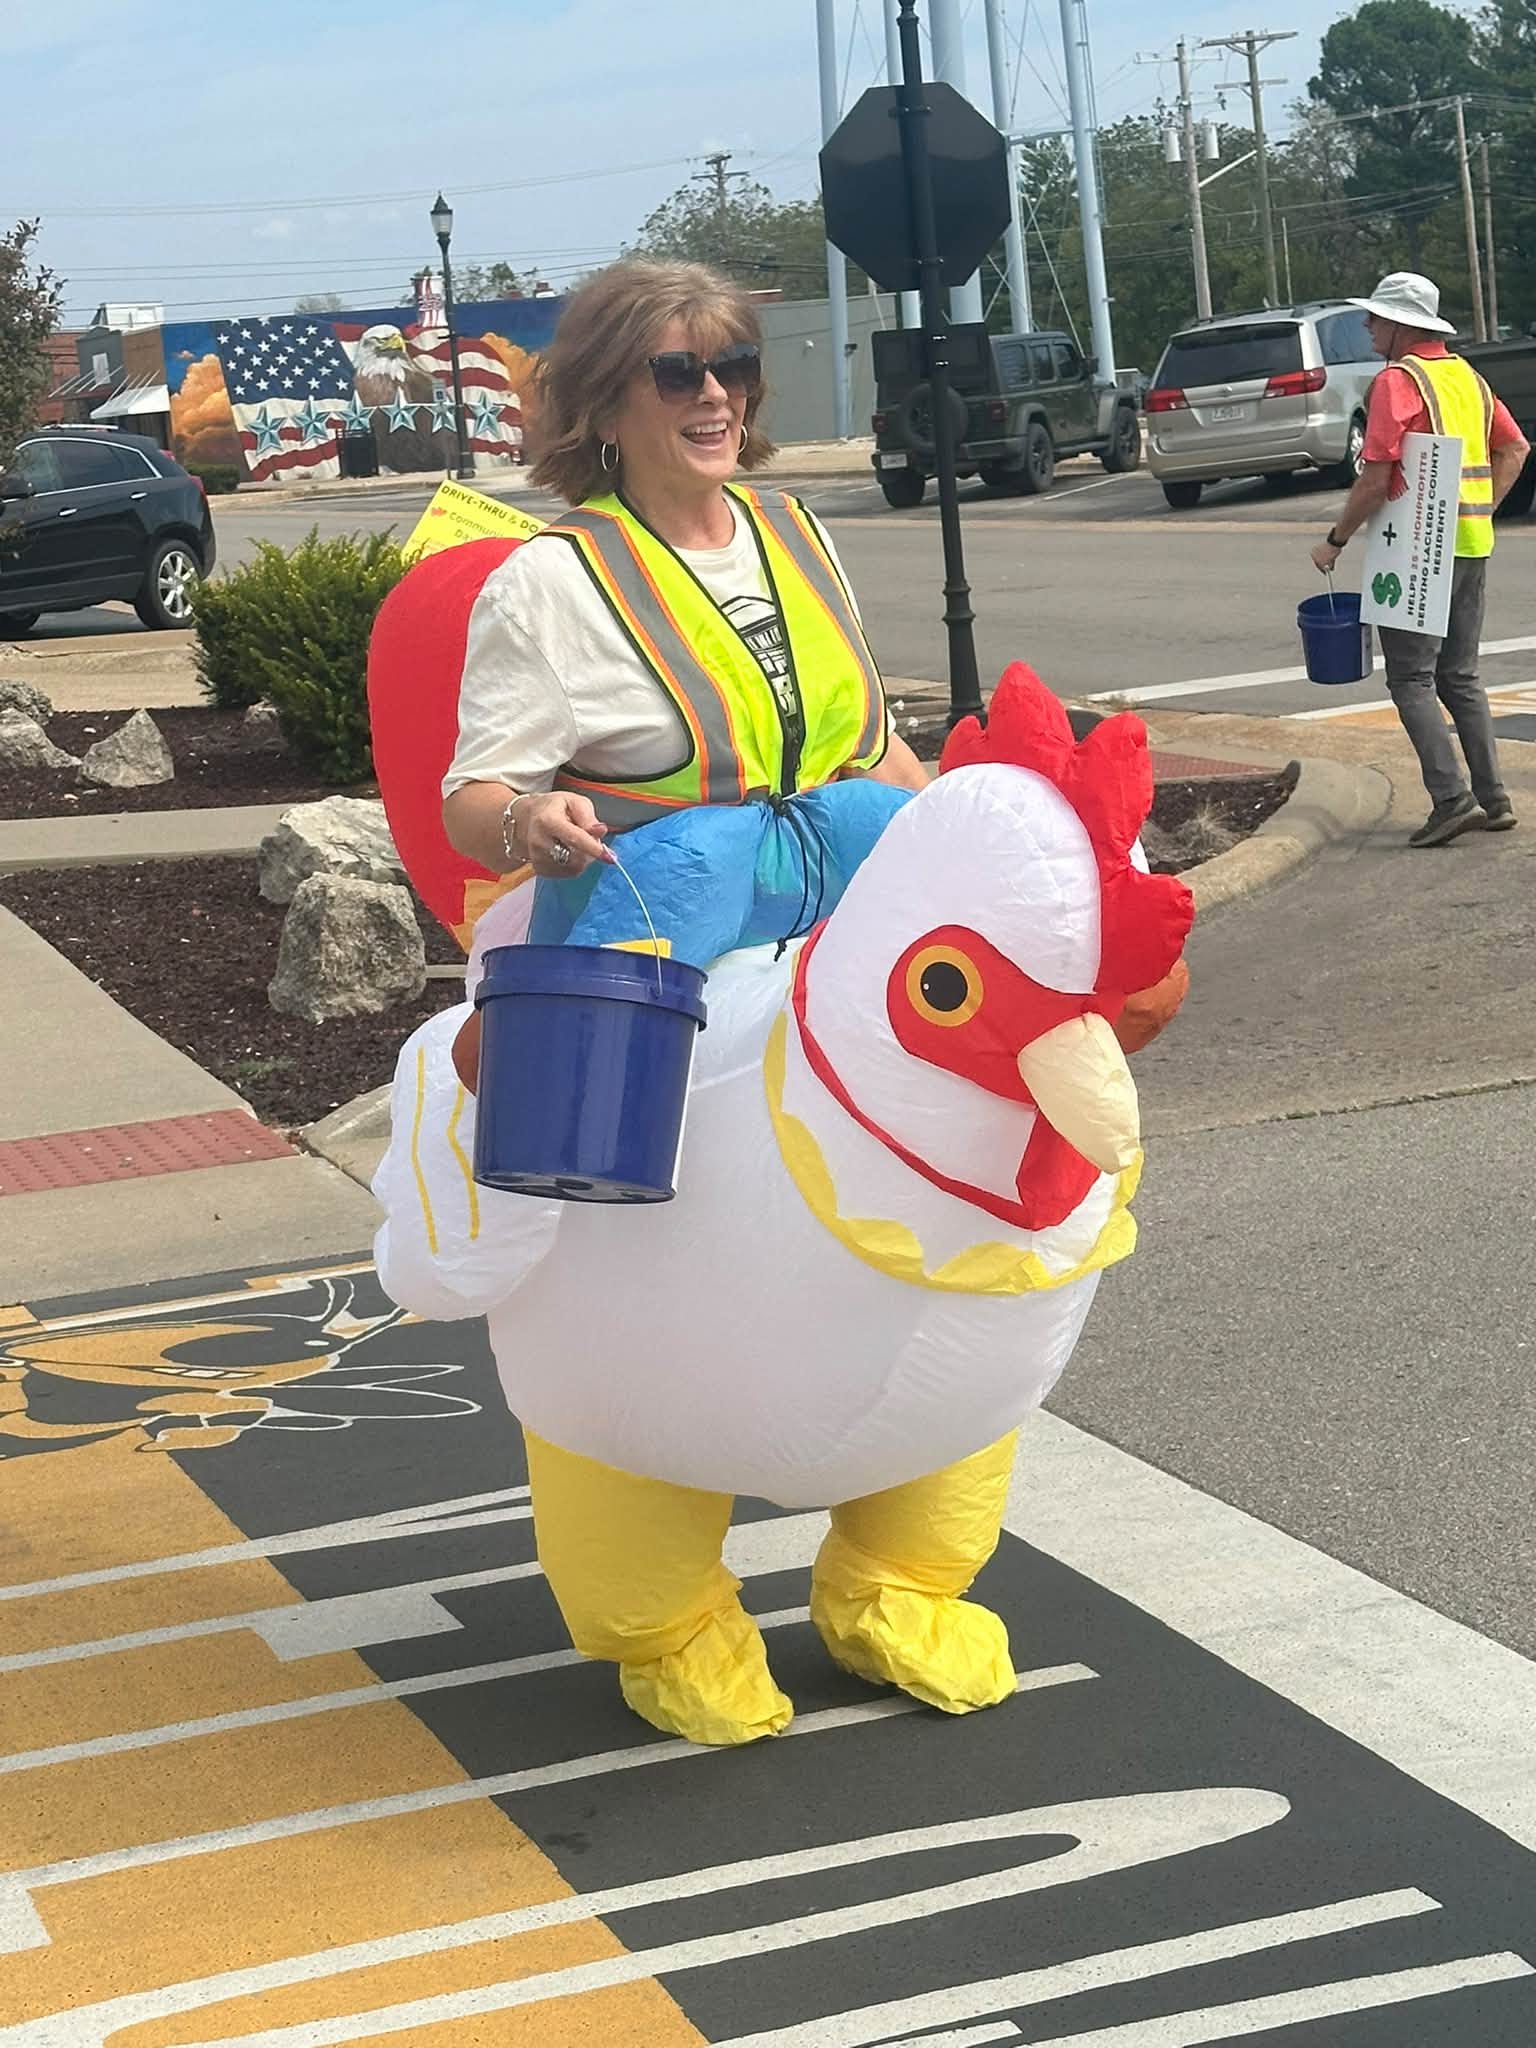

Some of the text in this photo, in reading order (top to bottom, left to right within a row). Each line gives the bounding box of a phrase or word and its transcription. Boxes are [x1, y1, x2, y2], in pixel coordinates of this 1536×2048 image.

[441, 485, 507, 519] DRIVE-THRU
[520, 519, 538, 533] DO
[1407, 574, 1417, 616] HELPS
[1413, 451, 1427, 541] NONPROFITS
[1417, 442, 1440, 628] SERVING LACLEDE COUNTY
[1433, 499, 1446, 575] RESIDENTS
